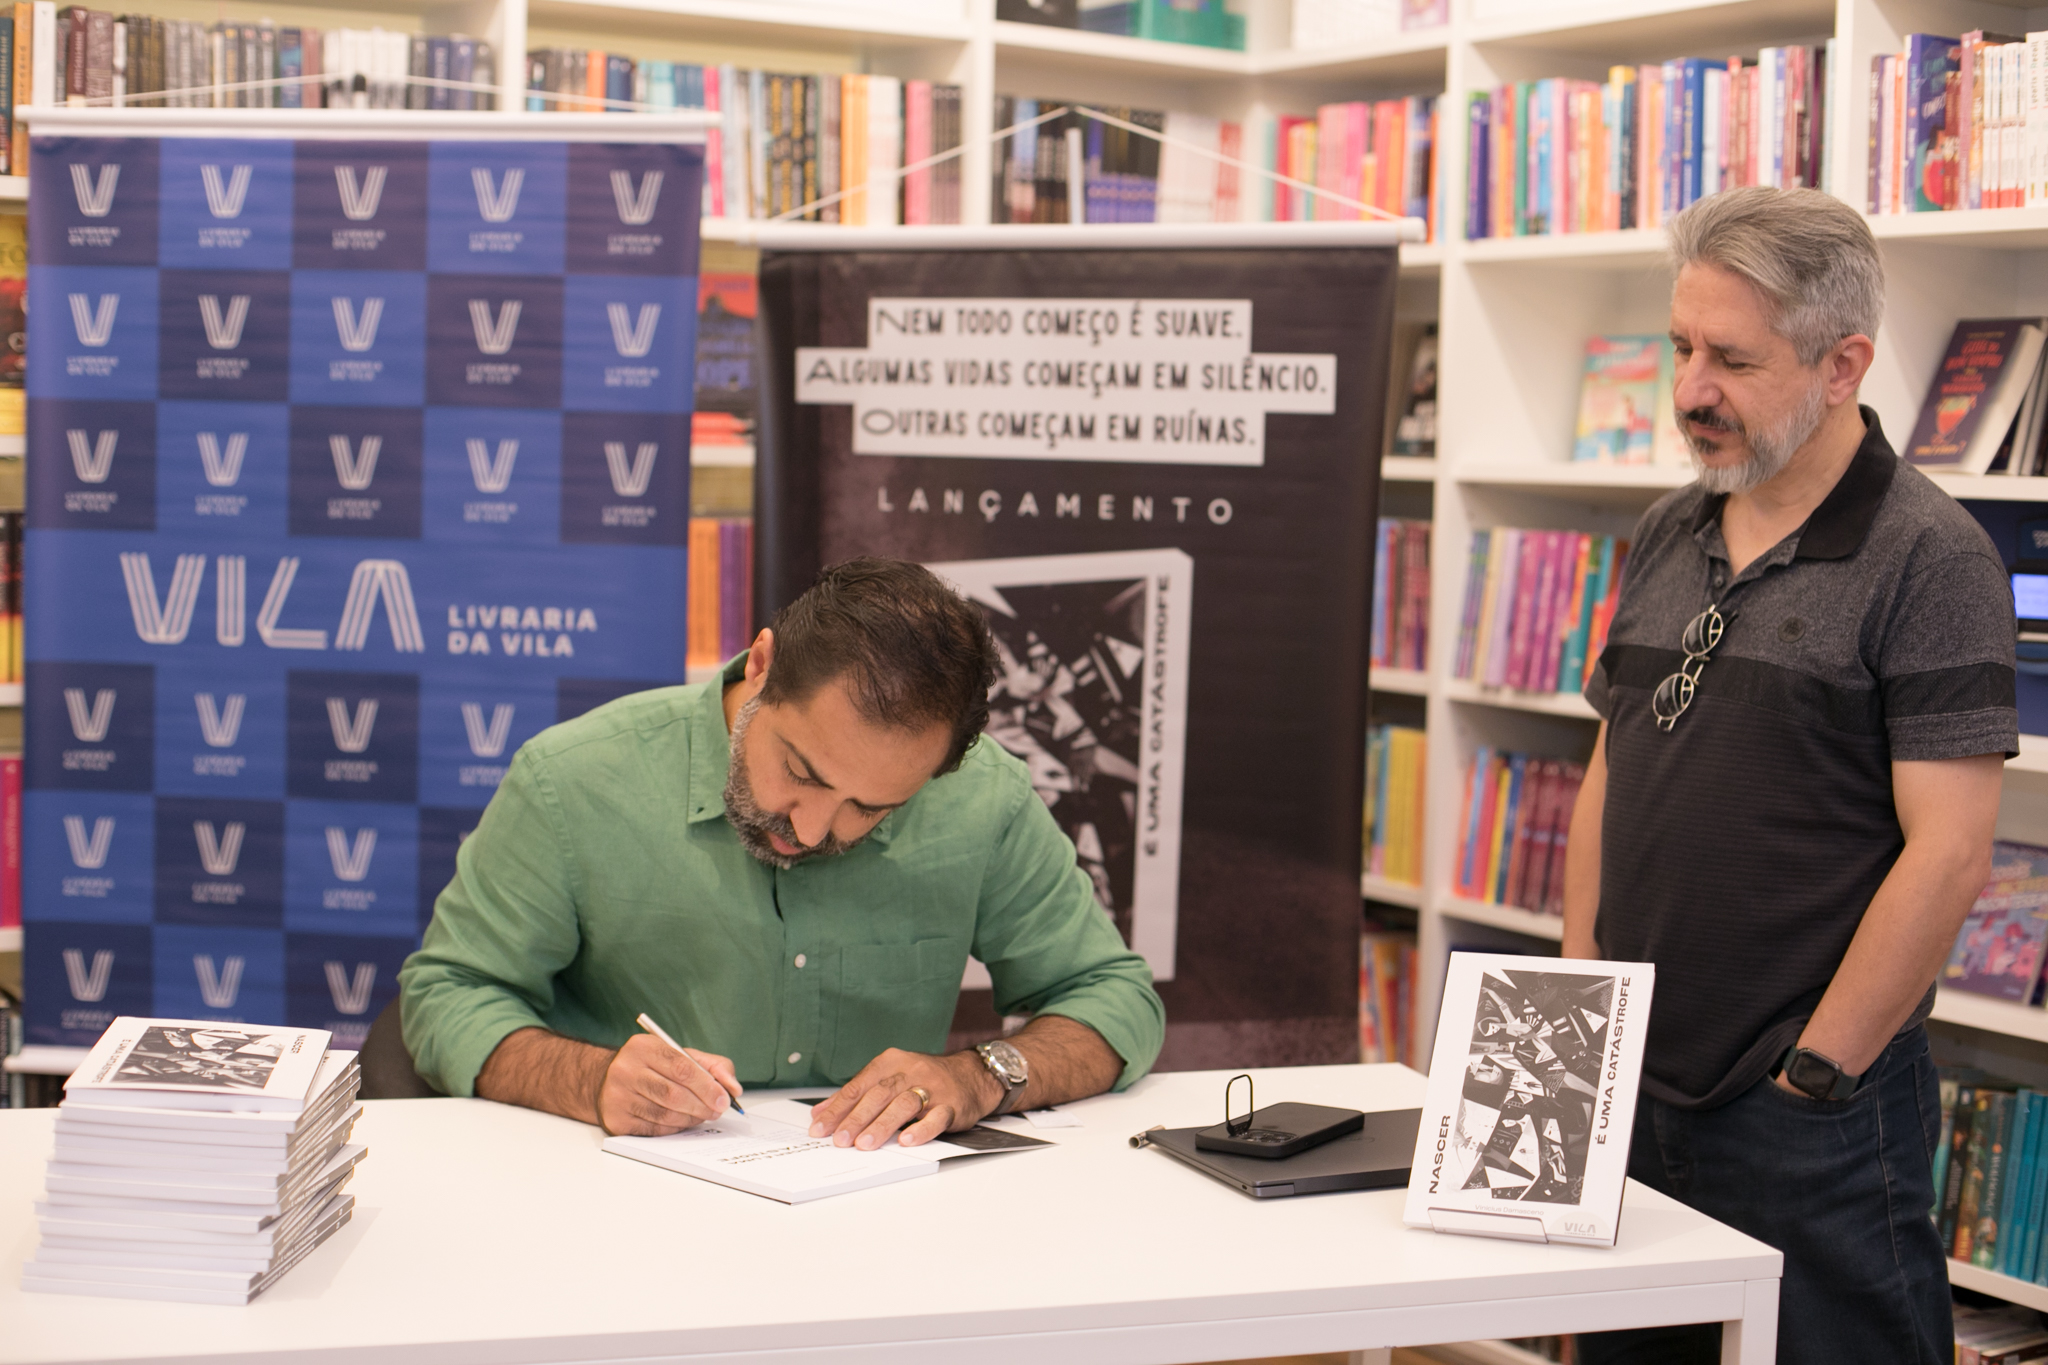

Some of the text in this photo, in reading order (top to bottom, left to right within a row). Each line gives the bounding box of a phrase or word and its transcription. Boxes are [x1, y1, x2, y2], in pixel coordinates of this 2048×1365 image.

[69, 163, 120, 217] V
[200, 164, 252, 219] V
[334, 165, 388, 220] V
[471, 168, 525, 223] V
[609, 170, 664, 225] V
[68, 293, 119, 347] V
[198, 295, 250, 349] V
[331, 297, 384, 352] V
[468, 300, 522, 355] V
[606, 303, 661, 358] V
[876, 301, 1243, 346] NEM TODO COMEÇO É SUAVE.
[805, 357, 1326, 399] ALGUMAS VIDAS COMEÇAM EM SILÊNCIO.
[66, 429, 118, 483] V
[861, 408, 1256, 450] OUTRAS COMEÇAM EM RUÍNAS.
[196, 433, 248, 487] V
[329, 435, 382, 490] V
[466, 439, 519, 493] V
[603, 442, 658, 497] V
[878, 486, 1233, 525] LANÇAMENTO
[119, 552, 425, 653] VILA
[448, 604, 598, 632] LIVRARIA
[448, 631, 574, 658] DA VILA
[63, 688, 116, 742] V
[194, 693, 246, 747] V
[326, 698, 379, 753] V
[461, 703, 515, 757] V
[1147, 760, 1162, 832] UMA
[63, 816, 114, 869] V
[194, 822, 245, 875] V
[325, 828, 377, 882] V
[62, 949, 114, 1002] V
[193, 956, 245, 1009] V
[324, 962, 376, 1015] V
[1595, 977, 1631, 1145] É UMA CATÁSTROFE
[1429, 1115, 1451, 1194] NASCER
[1475, 1204, 1545, 1216] Vinicius Damasceno
[1564, 1222, 1596, 1234] VILA
